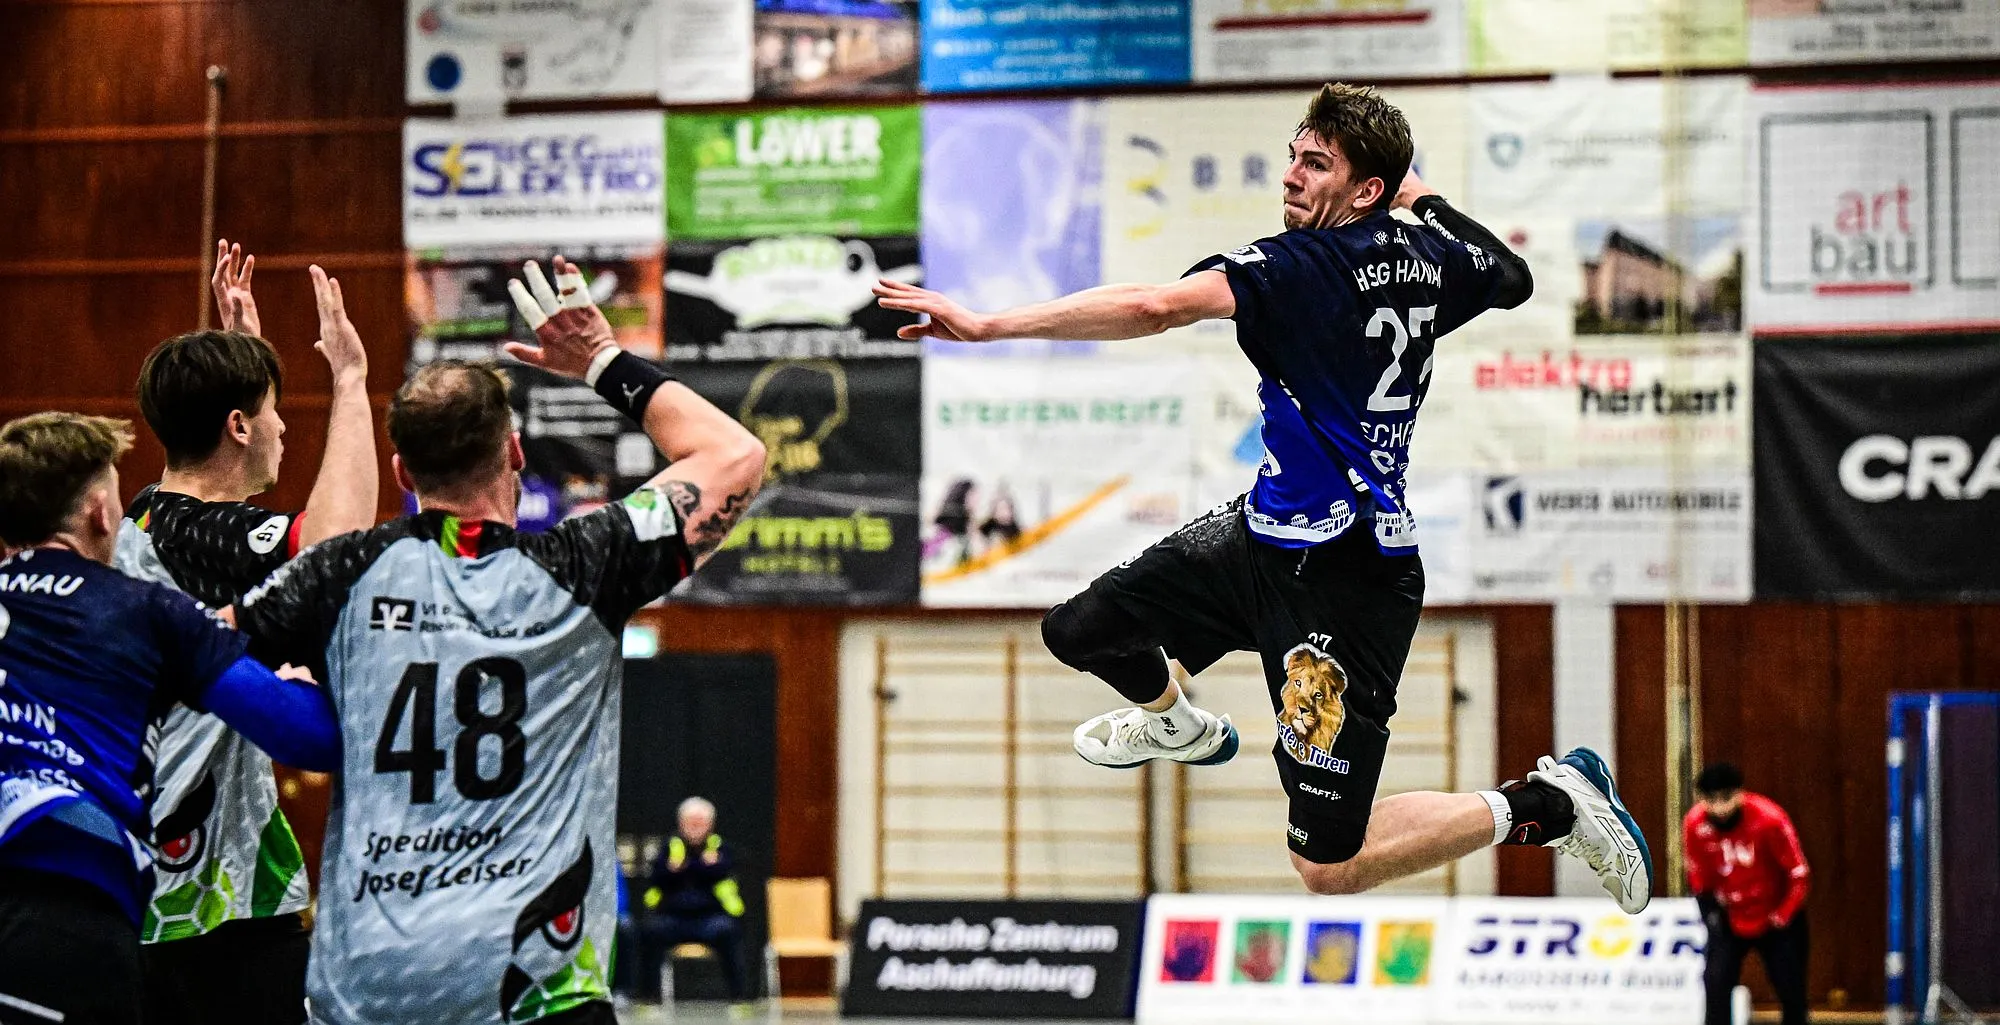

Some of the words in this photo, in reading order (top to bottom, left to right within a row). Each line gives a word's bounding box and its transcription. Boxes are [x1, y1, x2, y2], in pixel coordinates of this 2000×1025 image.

[1834, 183, 1911, 236] art
[1811, 223, 1917, 276] bau
[1353, 262, 1390, 292] HSG
[1476, 348, 1631, 391] elektro
[373, 656, 528, 805] 48
[1309, 744, 1350, 775] Türen
[1299, 782, 1332, 799] CRAFT
[362, 824, 503, 864] Spedition
[352, 864, 435, 903] Josef
[436, 857, 532, 889] Leiser
[866, 916, 991, 952] Porsche
[990, 916, 1119, 953] Zentrum
[875, 956, 1097, 1000] Aschaffenburg
